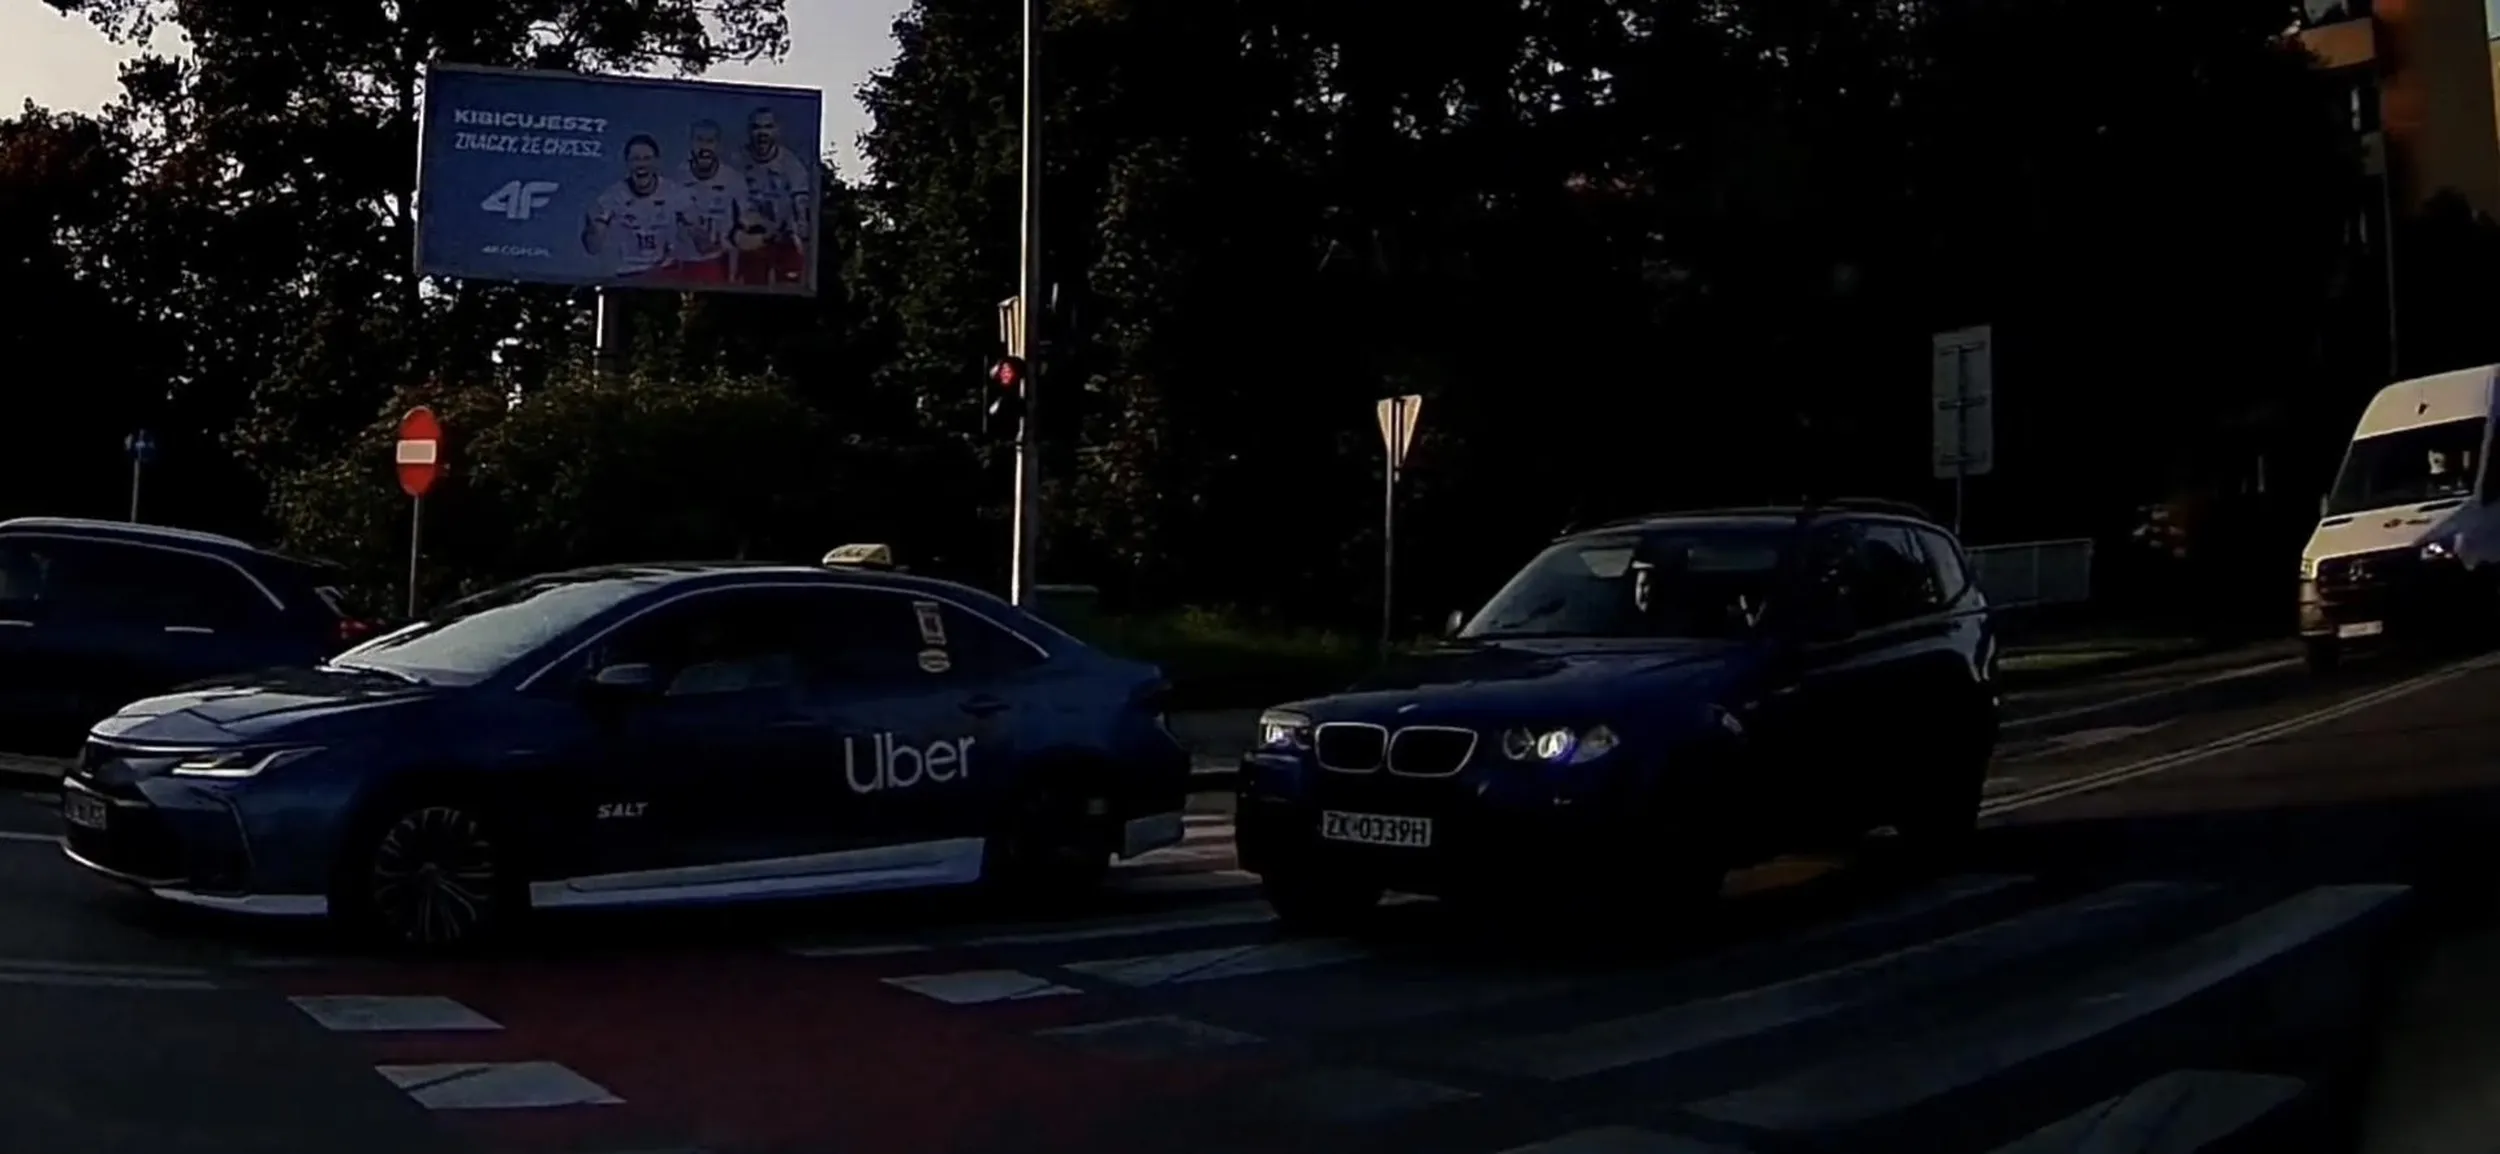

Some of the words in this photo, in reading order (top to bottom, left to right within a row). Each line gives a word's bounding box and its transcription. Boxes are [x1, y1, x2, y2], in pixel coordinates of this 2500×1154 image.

[454, 109, 608, 133] KIBICUJESZ?
[481, 180, 560, 219] 4F
[844, 732, 976, 795] Uber
[596, 801, 649, 819] SALT
